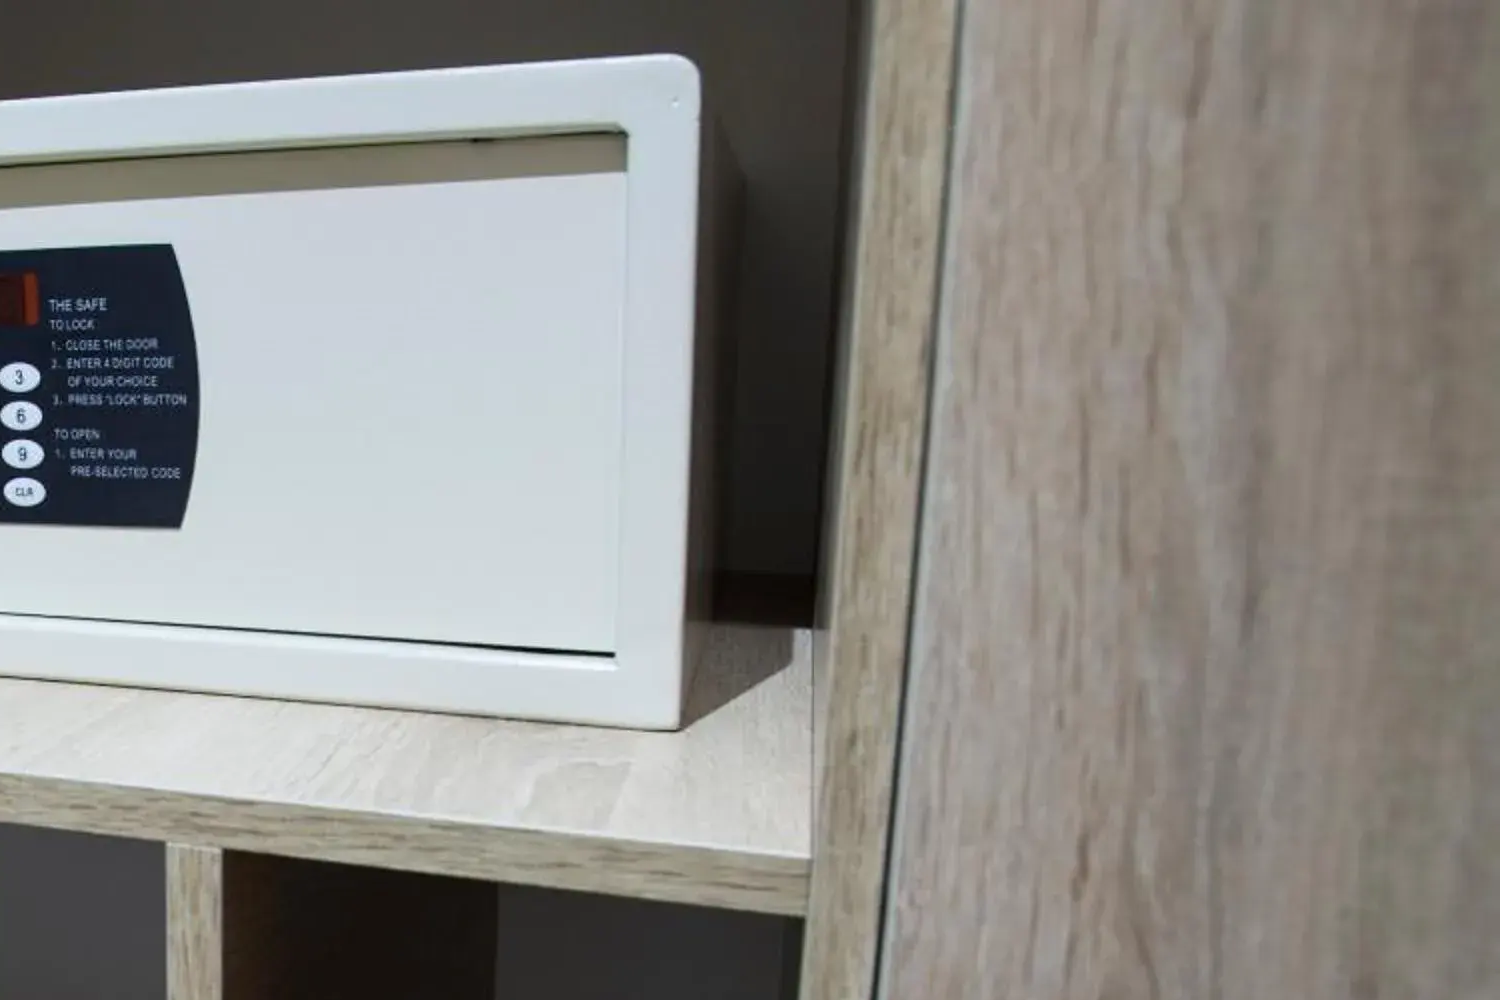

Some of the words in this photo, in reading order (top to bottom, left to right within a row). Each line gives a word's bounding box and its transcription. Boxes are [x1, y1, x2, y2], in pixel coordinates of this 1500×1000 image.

[48, 299, 73, 312] THE
[76, 298, 107, 311] SAFE
[50, 320, 63, 330] TO
[65, 319, 95, 330] LOCK
[65, 340, 100, 351] CLOSE
[103, 339, 123, 350] THE
[125, 338, 158, 350] DOOR
[67, 358, 102, 369] ENTER
[112, 358, 140, 368] DIGIT
[143, 357, 174, 368] CODE
[15, 370, 24, 385] 3
[68, 376, 81, 387] OF
[84, 376, 114, 387] YOUR
[116, 375, 158, 387] CHOICE
[68, 394, 103, 405] PRESS
[143, 394, 187, 405] BUTTON
[16, 408, 26, 423] 6
[54, 429, 68, 439] TO
[70, 429, 100, 440] OPEN
[18, 447, 27, 462] 9
[70, 448, 105, 459] ENTER
[107, 449, 137, 459] YOUR
[71, 466, 148, 478] PRE-SELECTED
[151, 467, 181, 479] CODE
